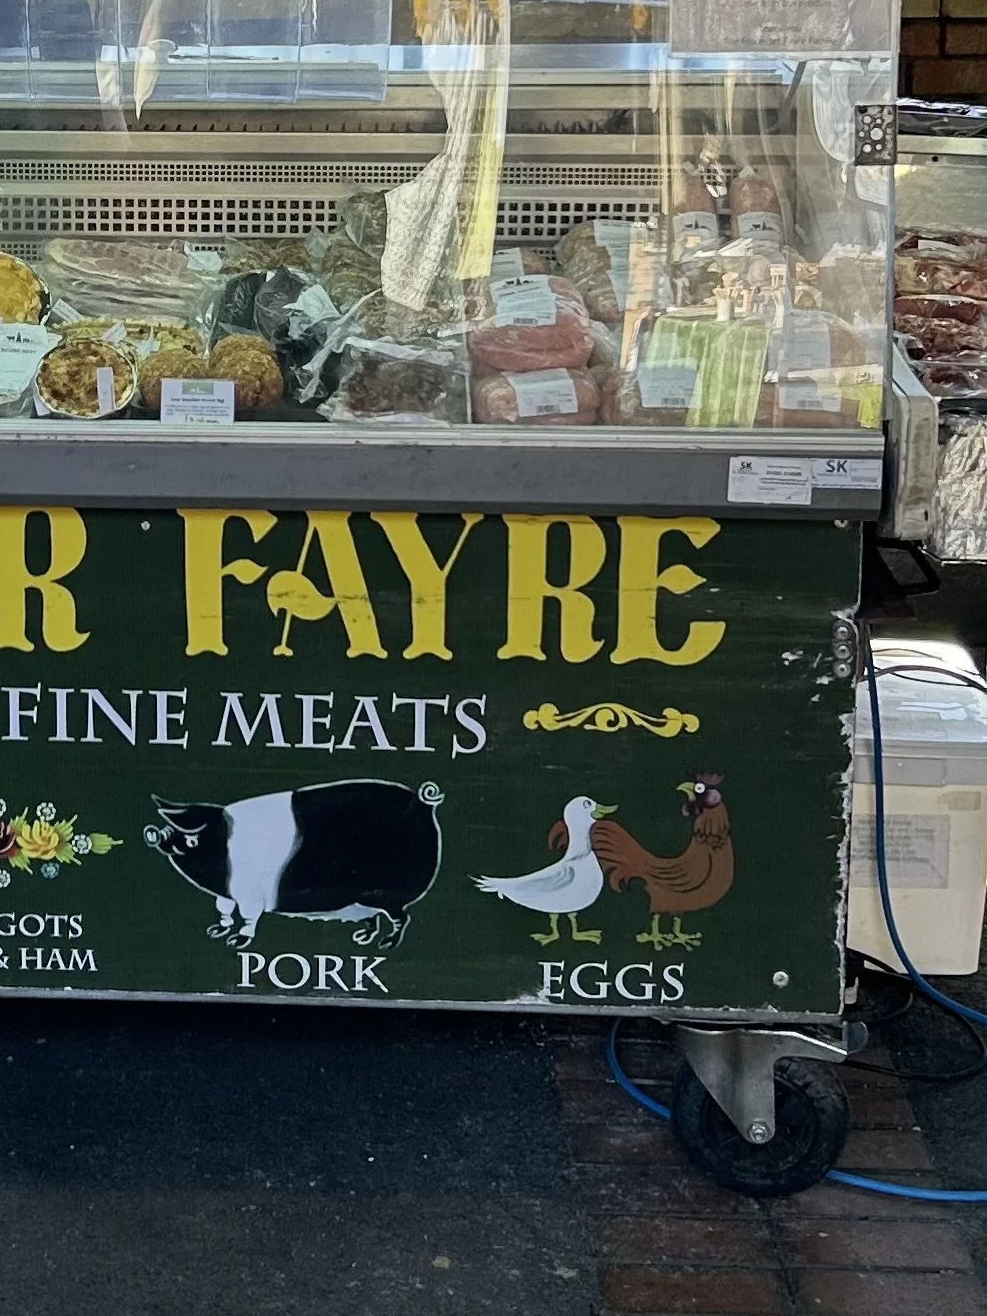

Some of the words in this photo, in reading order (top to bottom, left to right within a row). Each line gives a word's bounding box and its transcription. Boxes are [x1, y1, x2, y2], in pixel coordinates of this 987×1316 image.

[825, 460, 848, 473] SK
[176, 509, 727, 667] FAYRE
[0, 682, 189, 750] FINE
[212, 691, 487, 759] MEATS
[18, 947, 98, 972] HAM
[236, 951, 389, 994] PORK
[538, 960, 686, 1003] EGGS
